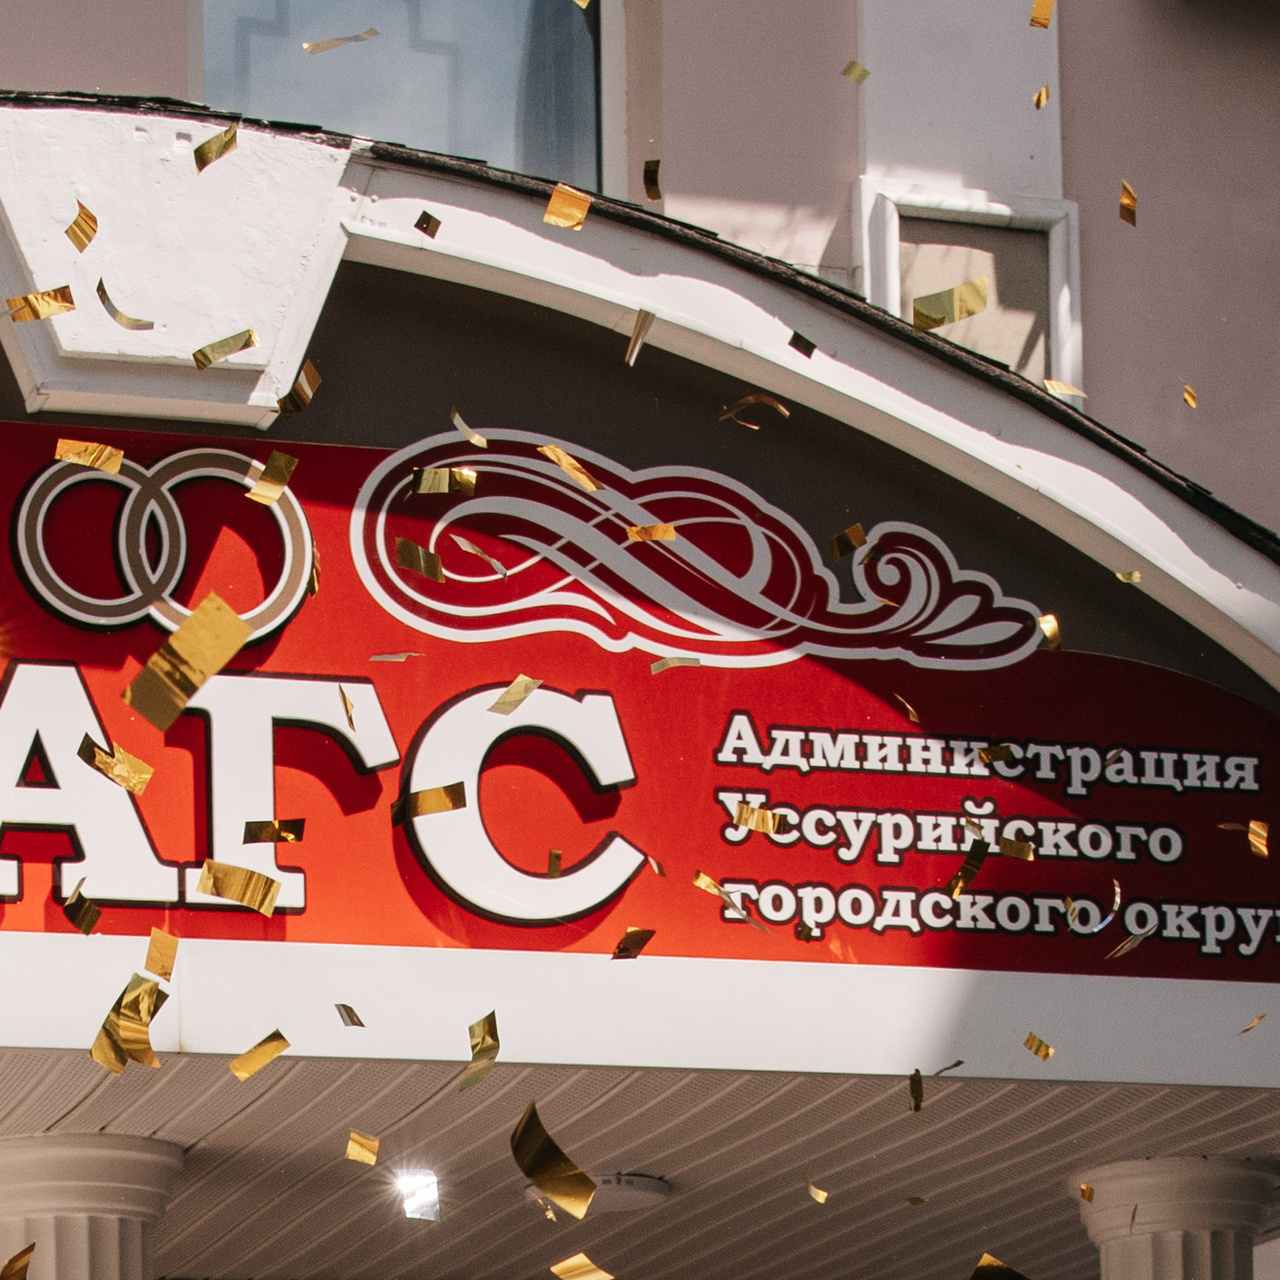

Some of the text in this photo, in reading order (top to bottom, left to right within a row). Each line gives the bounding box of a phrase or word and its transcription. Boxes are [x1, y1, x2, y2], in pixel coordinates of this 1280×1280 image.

[718, 715, 1259, 794] Администрация
[718, 792, 1182, 862] Уссурийского
[723, 881, 1280, 955] городского окру
